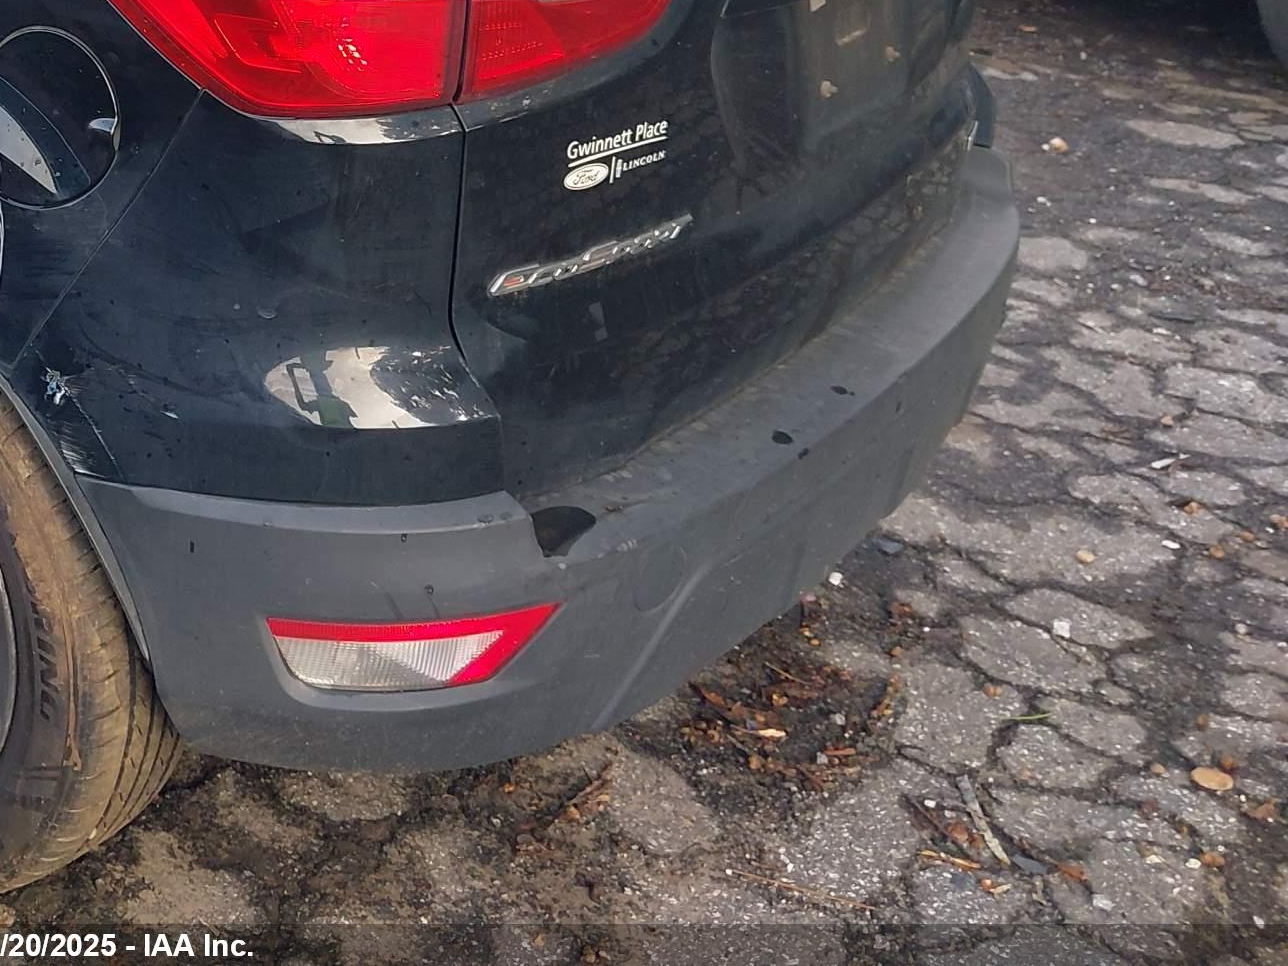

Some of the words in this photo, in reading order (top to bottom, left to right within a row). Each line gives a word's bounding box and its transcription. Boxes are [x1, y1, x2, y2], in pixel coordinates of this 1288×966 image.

[567, 128, 633, 159] Gwinnett
[634, 120, 669, 142] Place
[622, 150, 667, 171] LINCOLN
